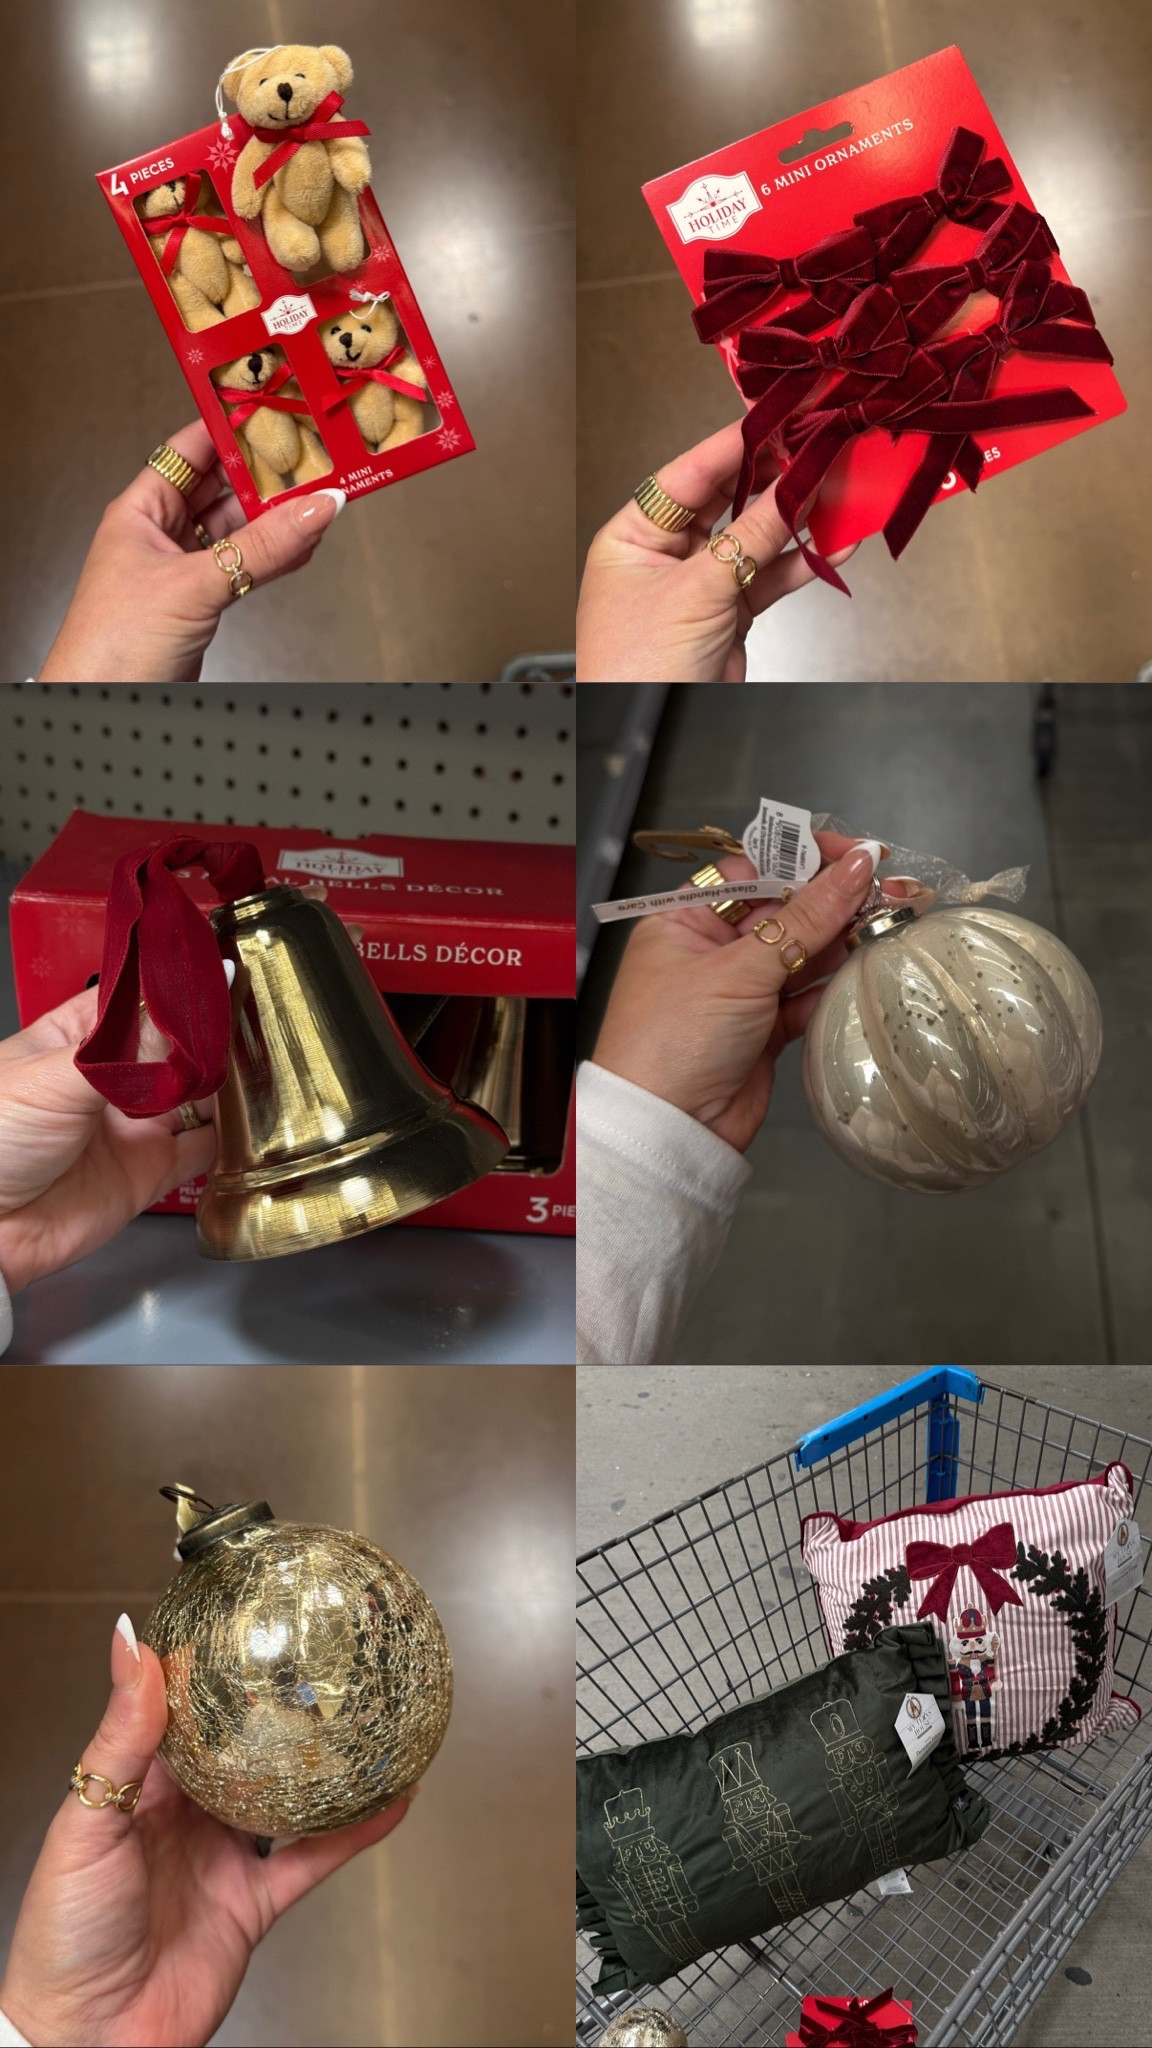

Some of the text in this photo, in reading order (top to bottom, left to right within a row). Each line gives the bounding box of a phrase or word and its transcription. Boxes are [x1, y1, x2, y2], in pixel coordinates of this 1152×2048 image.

[761, 118, 914, 196] 6 MINI ORNAMENTS
[111, 157, 175, 196] 4 PIECES
[688, 197, 747, 233] HOLIDAY
[708, 215, 739, 234] TIME
[273, 309, 309, 330] HOLIDAY
[339, 465, 373, 485] 4 MINI
[296, 861, 384, 873] HOLIDAY
[309, 879, 396, 890] BELLS
[406, 884, 504, 896] DÉCOR
[618, 884, 758, 912] Glass-Handle with Care
[435, 942, 522, 966] DÉCOR
[525, 1196, 576, 1223] 3 PIE
